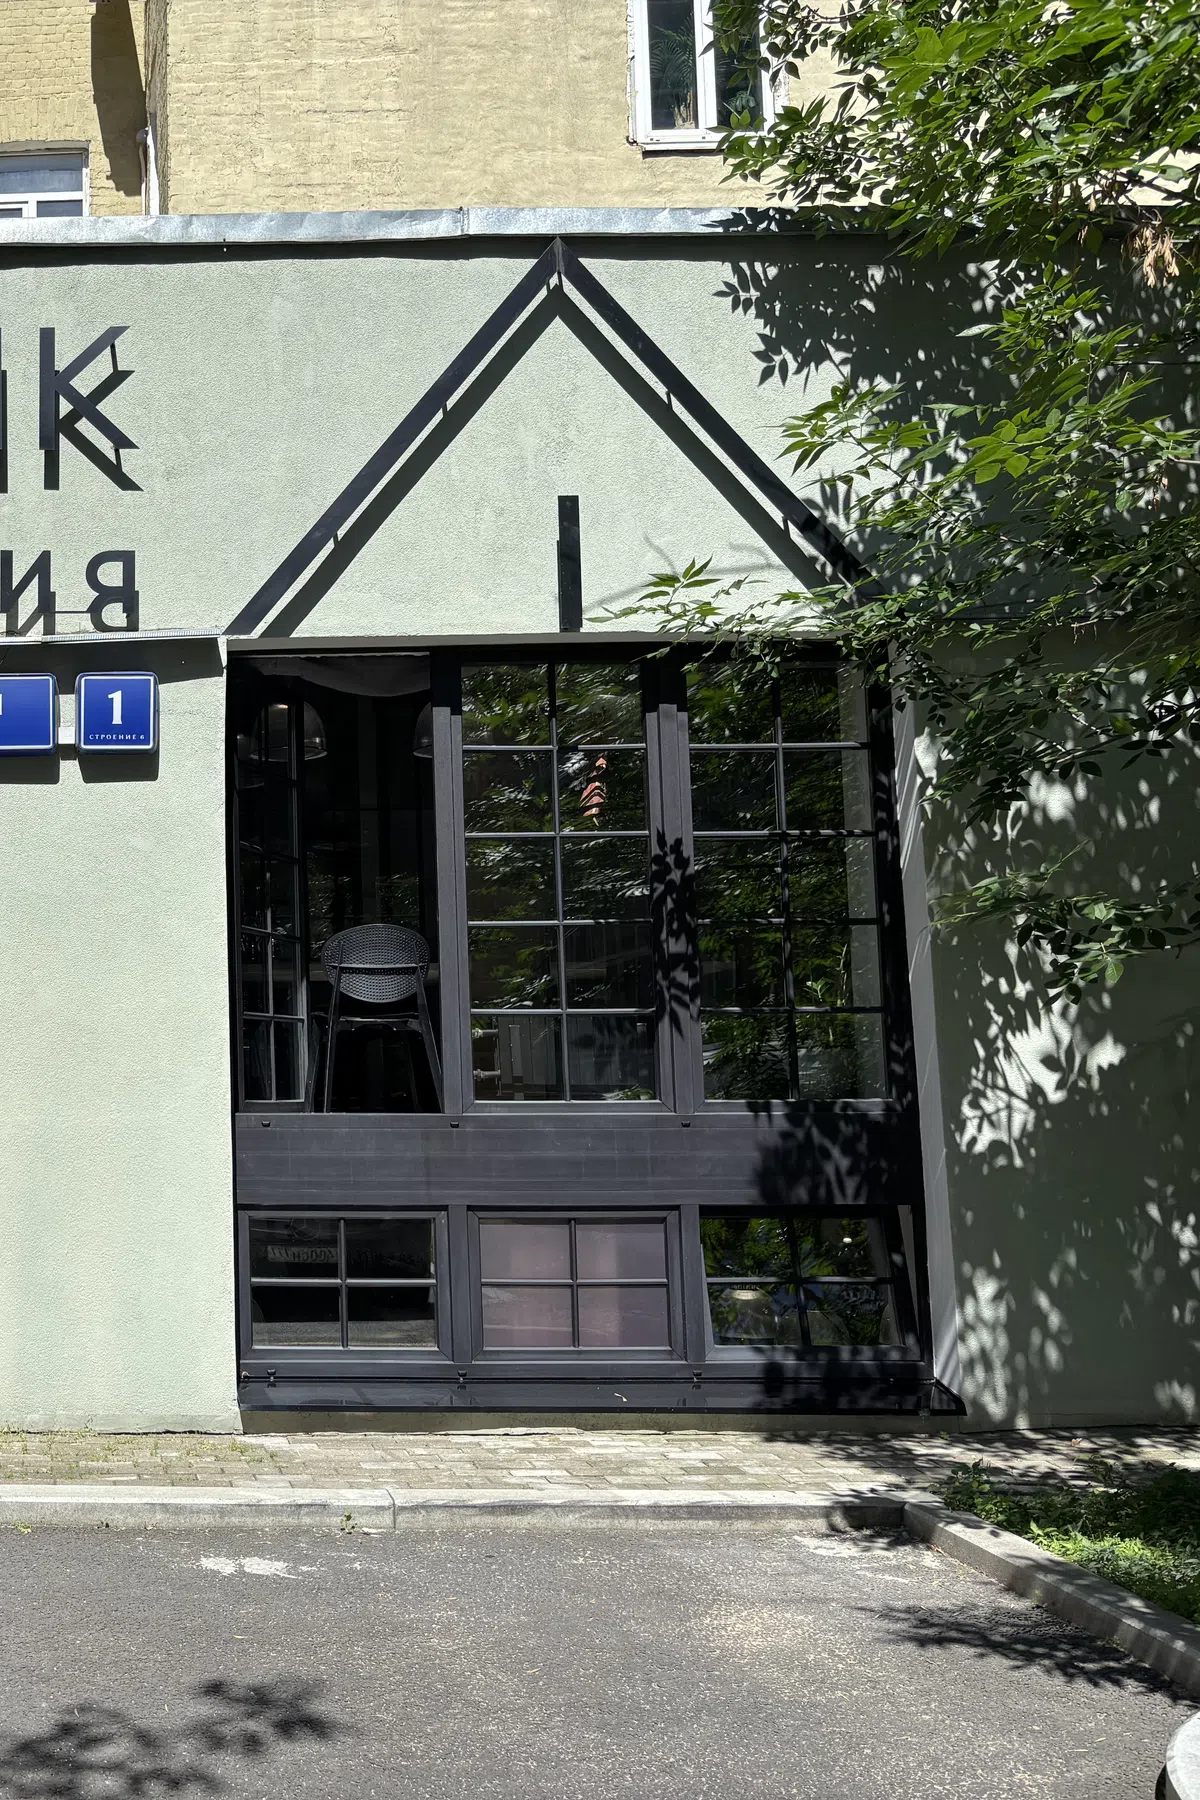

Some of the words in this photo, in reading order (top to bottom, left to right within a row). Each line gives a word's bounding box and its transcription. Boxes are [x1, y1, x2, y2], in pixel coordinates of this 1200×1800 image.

[107, 689, 123, 725] 1
[88, 733, 137, 741] СТРОЕНИЕ
[139, 733, 145, 741] 6
